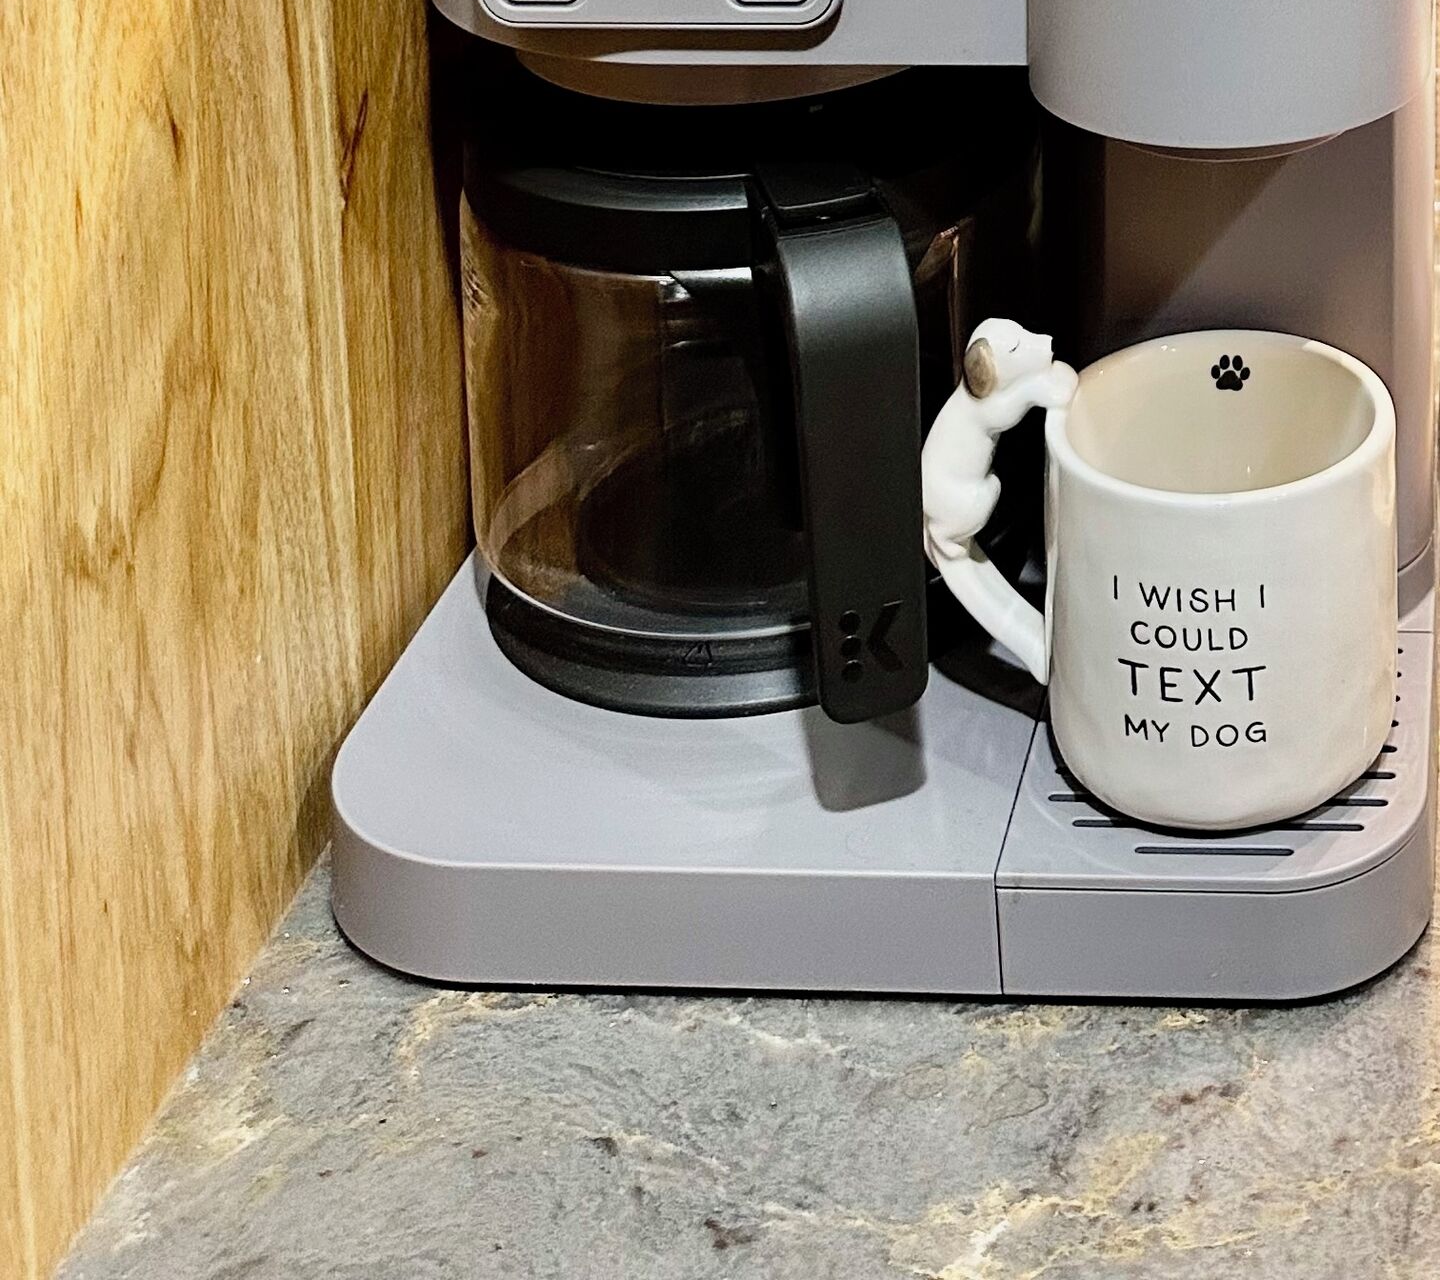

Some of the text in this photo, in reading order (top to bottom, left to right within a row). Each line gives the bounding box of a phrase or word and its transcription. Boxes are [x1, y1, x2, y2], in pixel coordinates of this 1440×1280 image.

[1113, 574, 1266, 613] I WISH I
[1130, 621, 1249, 652] COULD
[1118, 658, 1267, 706] TEXT
[1125, 714, 1268, 748] MY DOG
